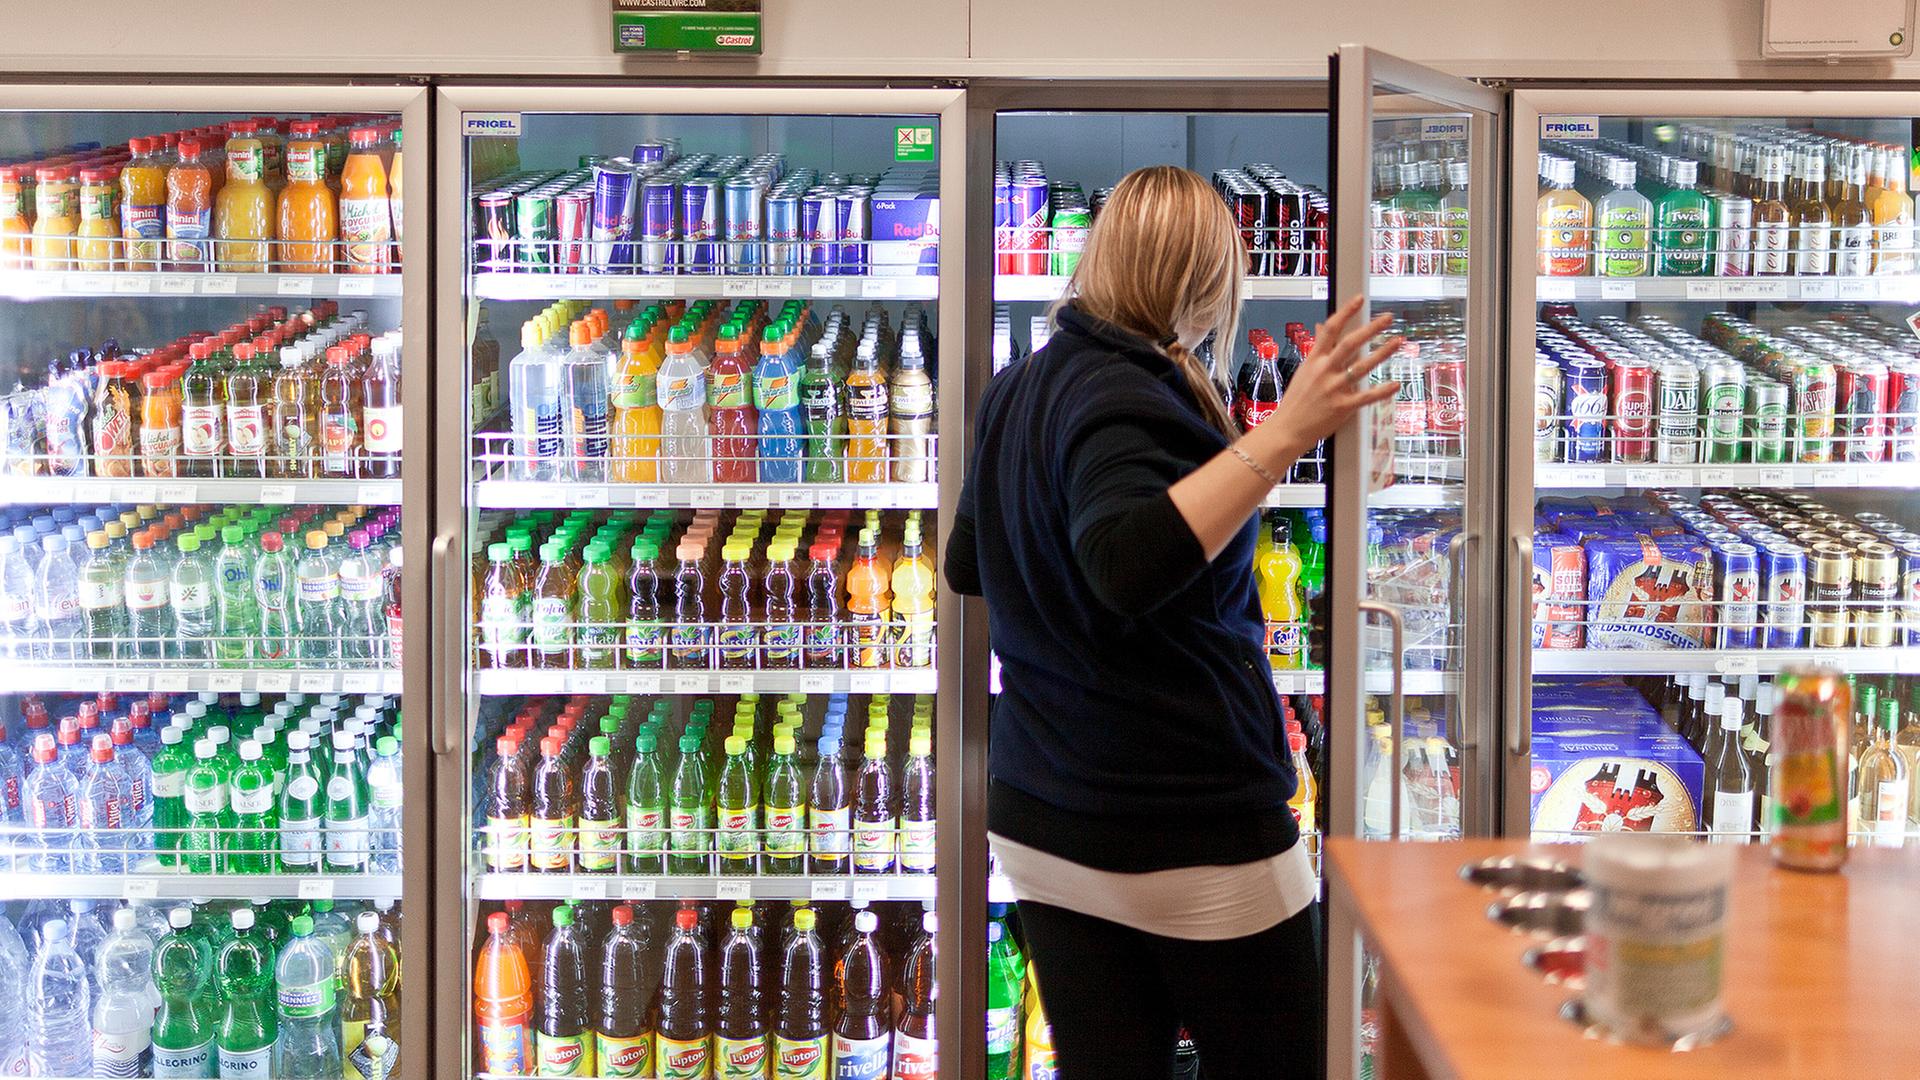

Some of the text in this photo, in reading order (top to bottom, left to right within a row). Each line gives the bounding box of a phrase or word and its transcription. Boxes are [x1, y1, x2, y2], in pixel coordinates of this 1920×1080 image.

[725, 36, 752, 44] Castrol
[468, 120, 516, 128] FRIGEL
[1546, 124, 1594, 132] FRIGEL
[893, 222, 922, 237] Red
[1254, 219, 1263, 251] zero
[1290, 219, 1300, 251] zero
[225, 567, 249, 582] Oh!
[107, 799, 121, 828] Vittel
[280, 993, 321, 1004] HENNIEZ
[546, 1045, 580, 1063] Lipton
[731, 1044, 765, 1064] Lipton
[837, 1039, 852, 1053] Win
[611, 1047, 646, 1066] Lipton
[672, 1049, 705, 1068] Lipton
[782, 1049, 819, 1066] Lipton
